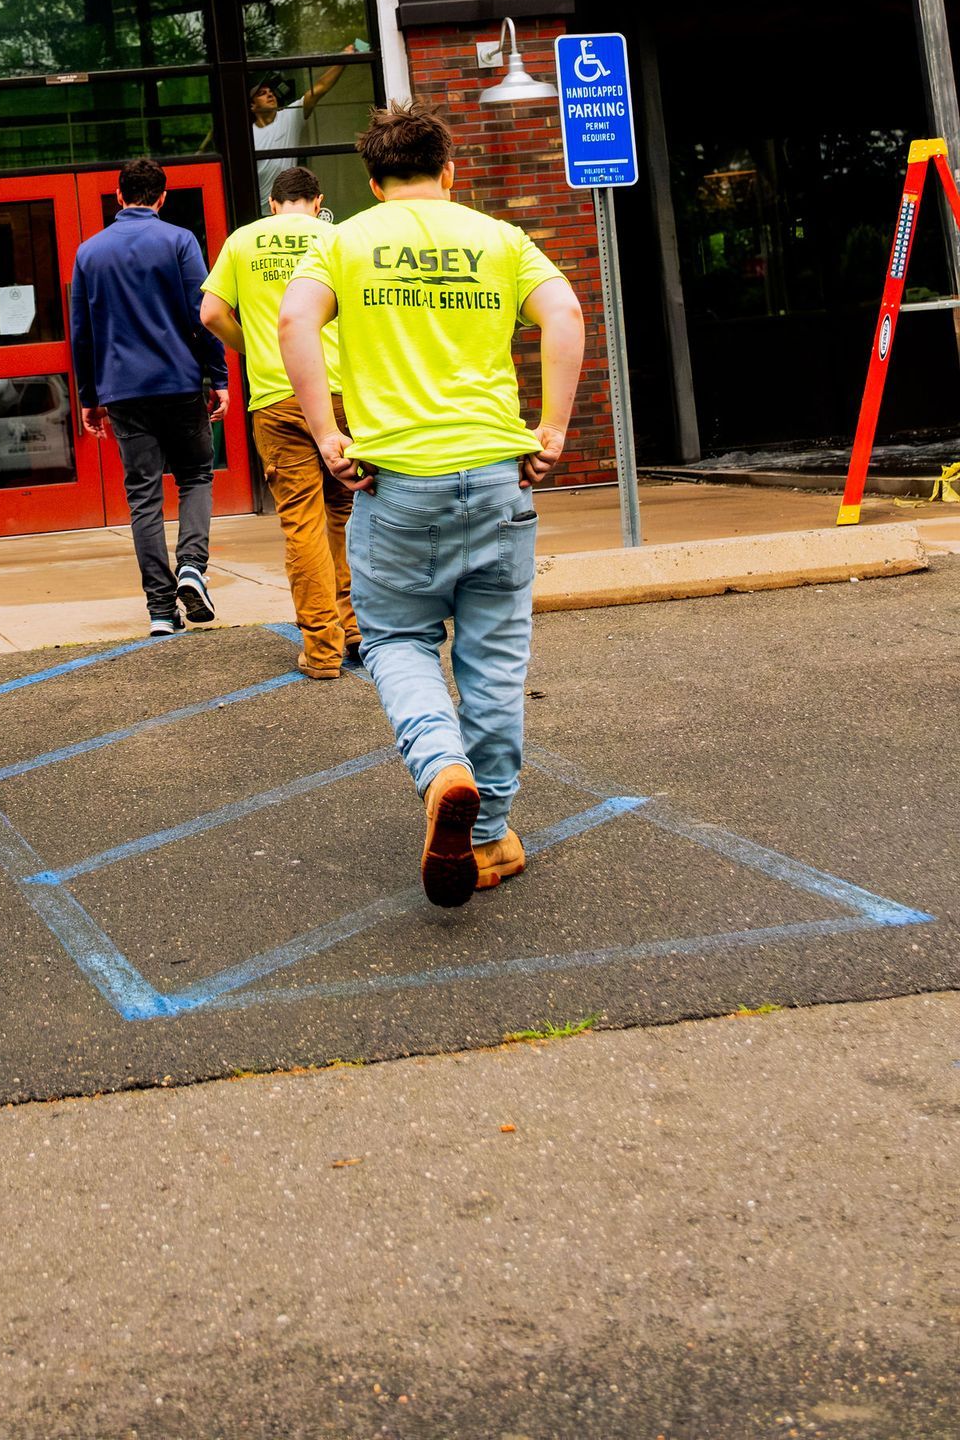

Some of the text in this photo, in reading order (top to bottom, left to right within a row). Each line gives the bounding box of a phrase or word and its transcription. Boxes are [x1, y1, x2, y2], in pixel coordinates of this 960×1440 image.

[566, 85, 623, 99] HANDICAPPED
[568, 102, 625, 119] PARKING
[585, 122, 610, 131] PERMIT
[582, 133, 616, 142] REQUIRED
[256, 234, 318, 249] CASE
[251, 257, 295, 272] ELECTRICAL
[373, 246, 484, 272] CASEY
[363, 288, 501, 310] ELECTRICAL SERVICES
